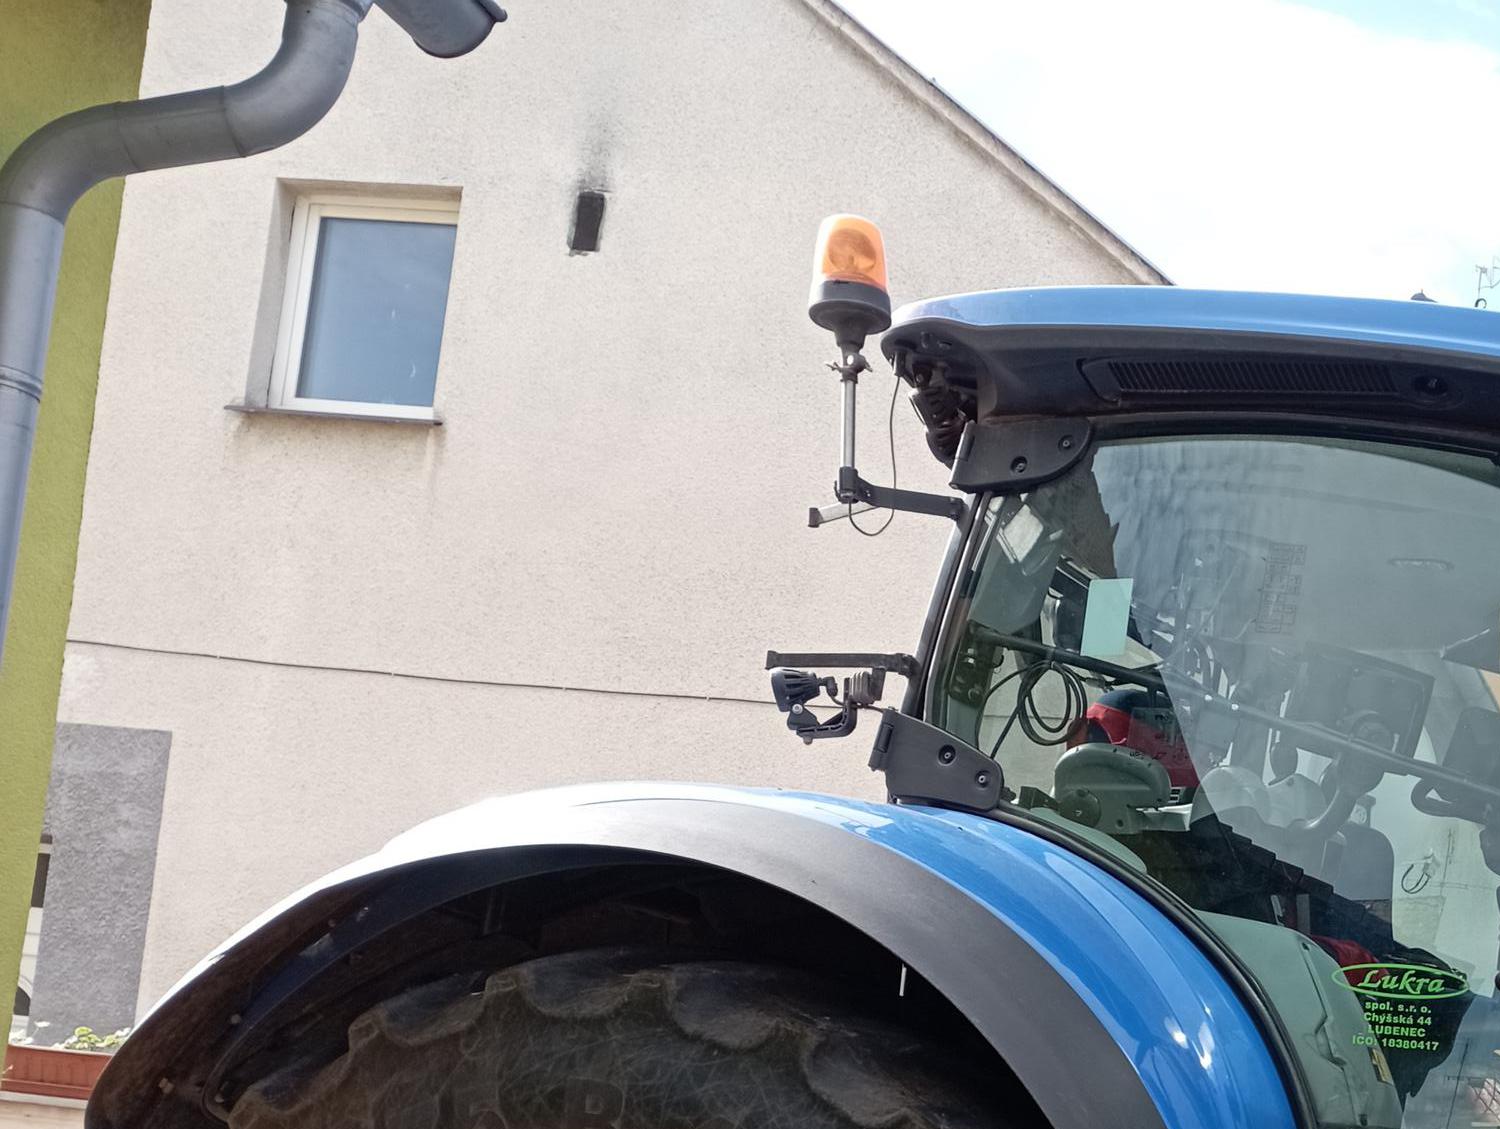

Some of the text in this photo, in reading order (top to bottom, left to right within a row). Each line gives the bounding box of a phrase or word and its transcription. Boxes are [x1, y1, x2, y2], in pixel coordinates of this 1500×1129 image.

[1357, 969, 1445, 995] Lukra
[1365, 1001, 1432, 1014] spol. s.r. o.
[1363, 1011, 1432, 1026] Chýšská 44
[1368, 1024, 1426, 1037] LUBENEC
